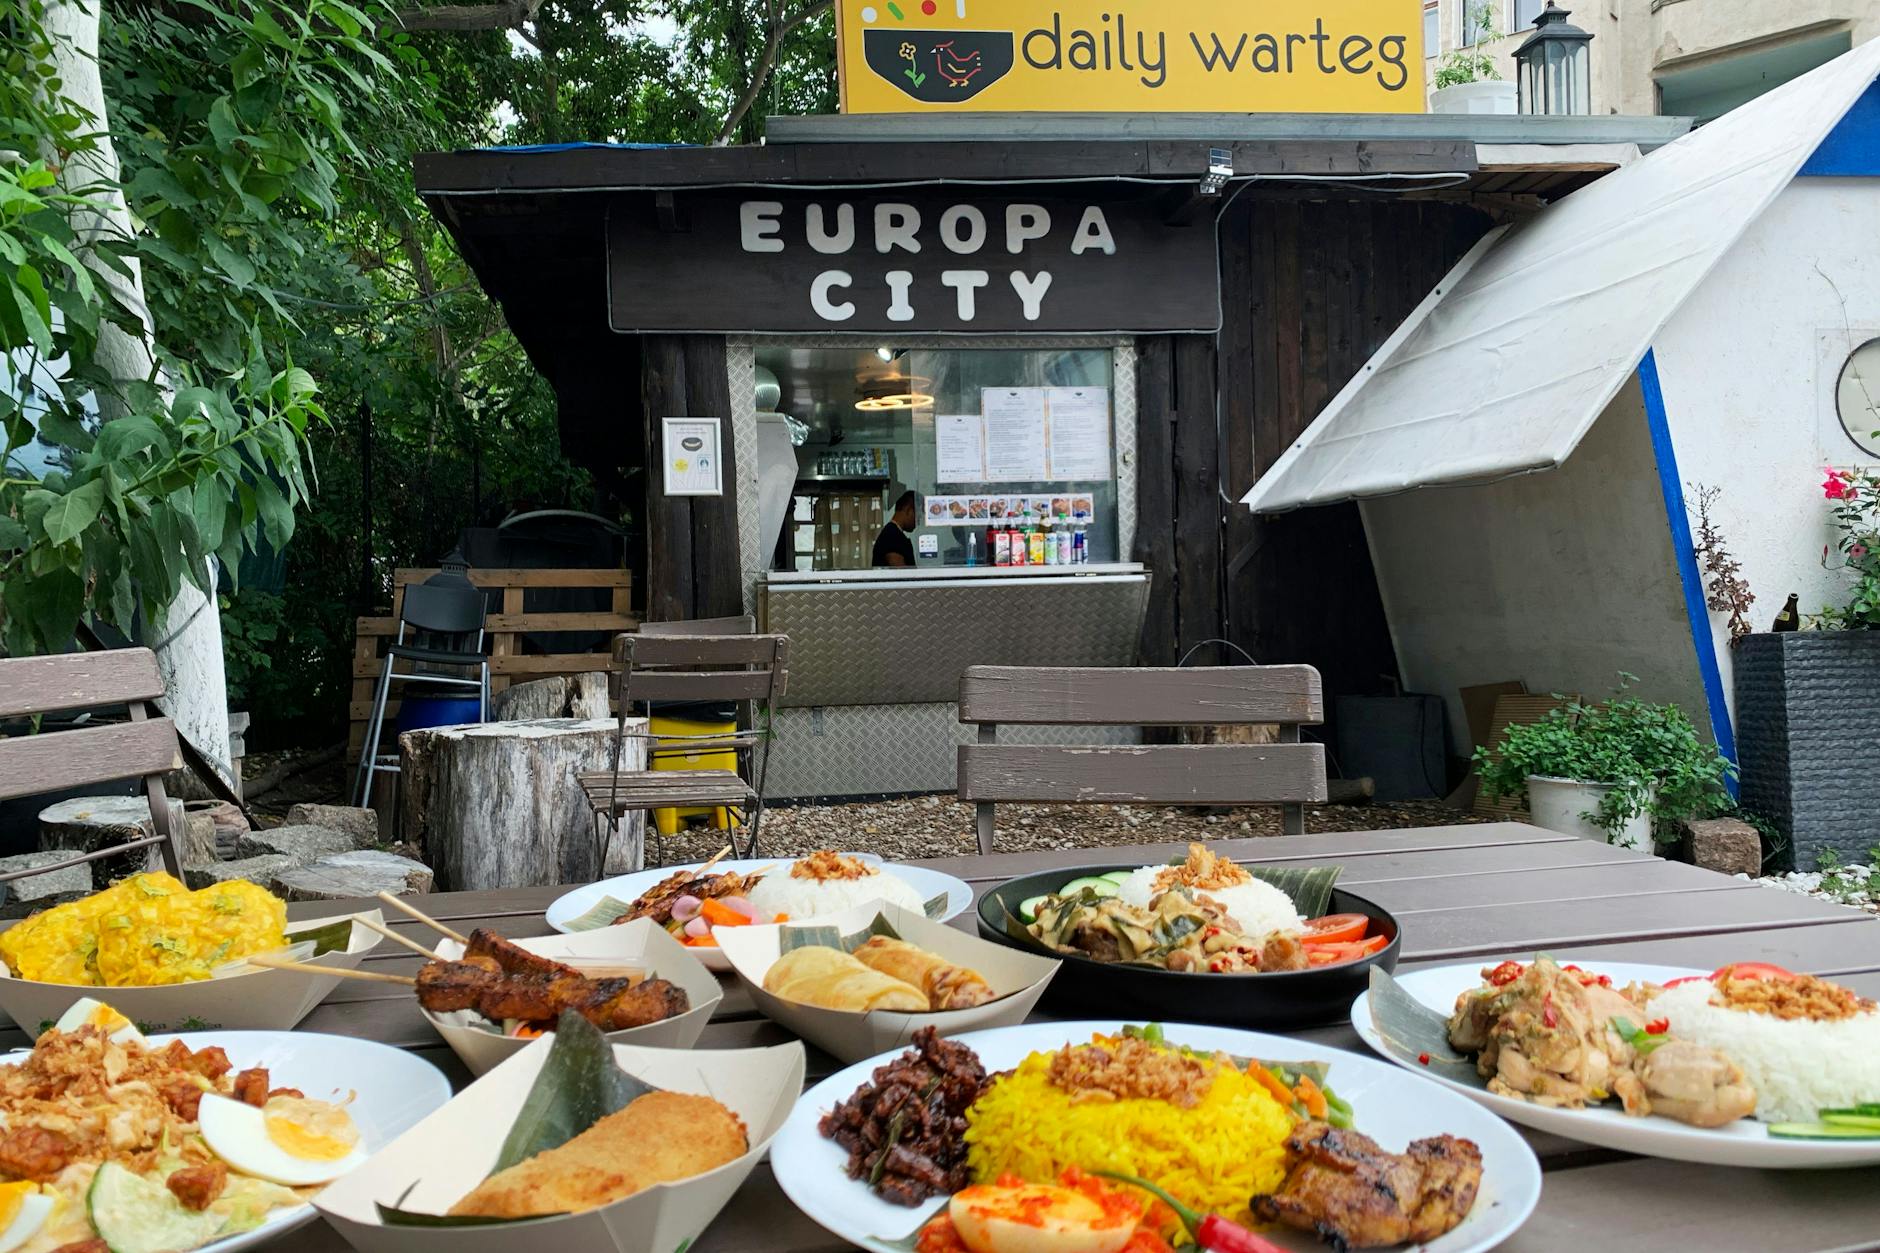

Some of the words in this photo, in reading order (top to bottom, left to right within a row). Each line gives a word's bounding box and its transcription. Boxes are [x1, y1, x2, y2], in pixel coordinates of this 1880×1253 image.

[1021, 12, 1167, 89] daily
[1189, 17, 1408, 92] warteg
[739, 200, 1117, 256] EUROPA
[809, 270, 1053, 323] CITY
